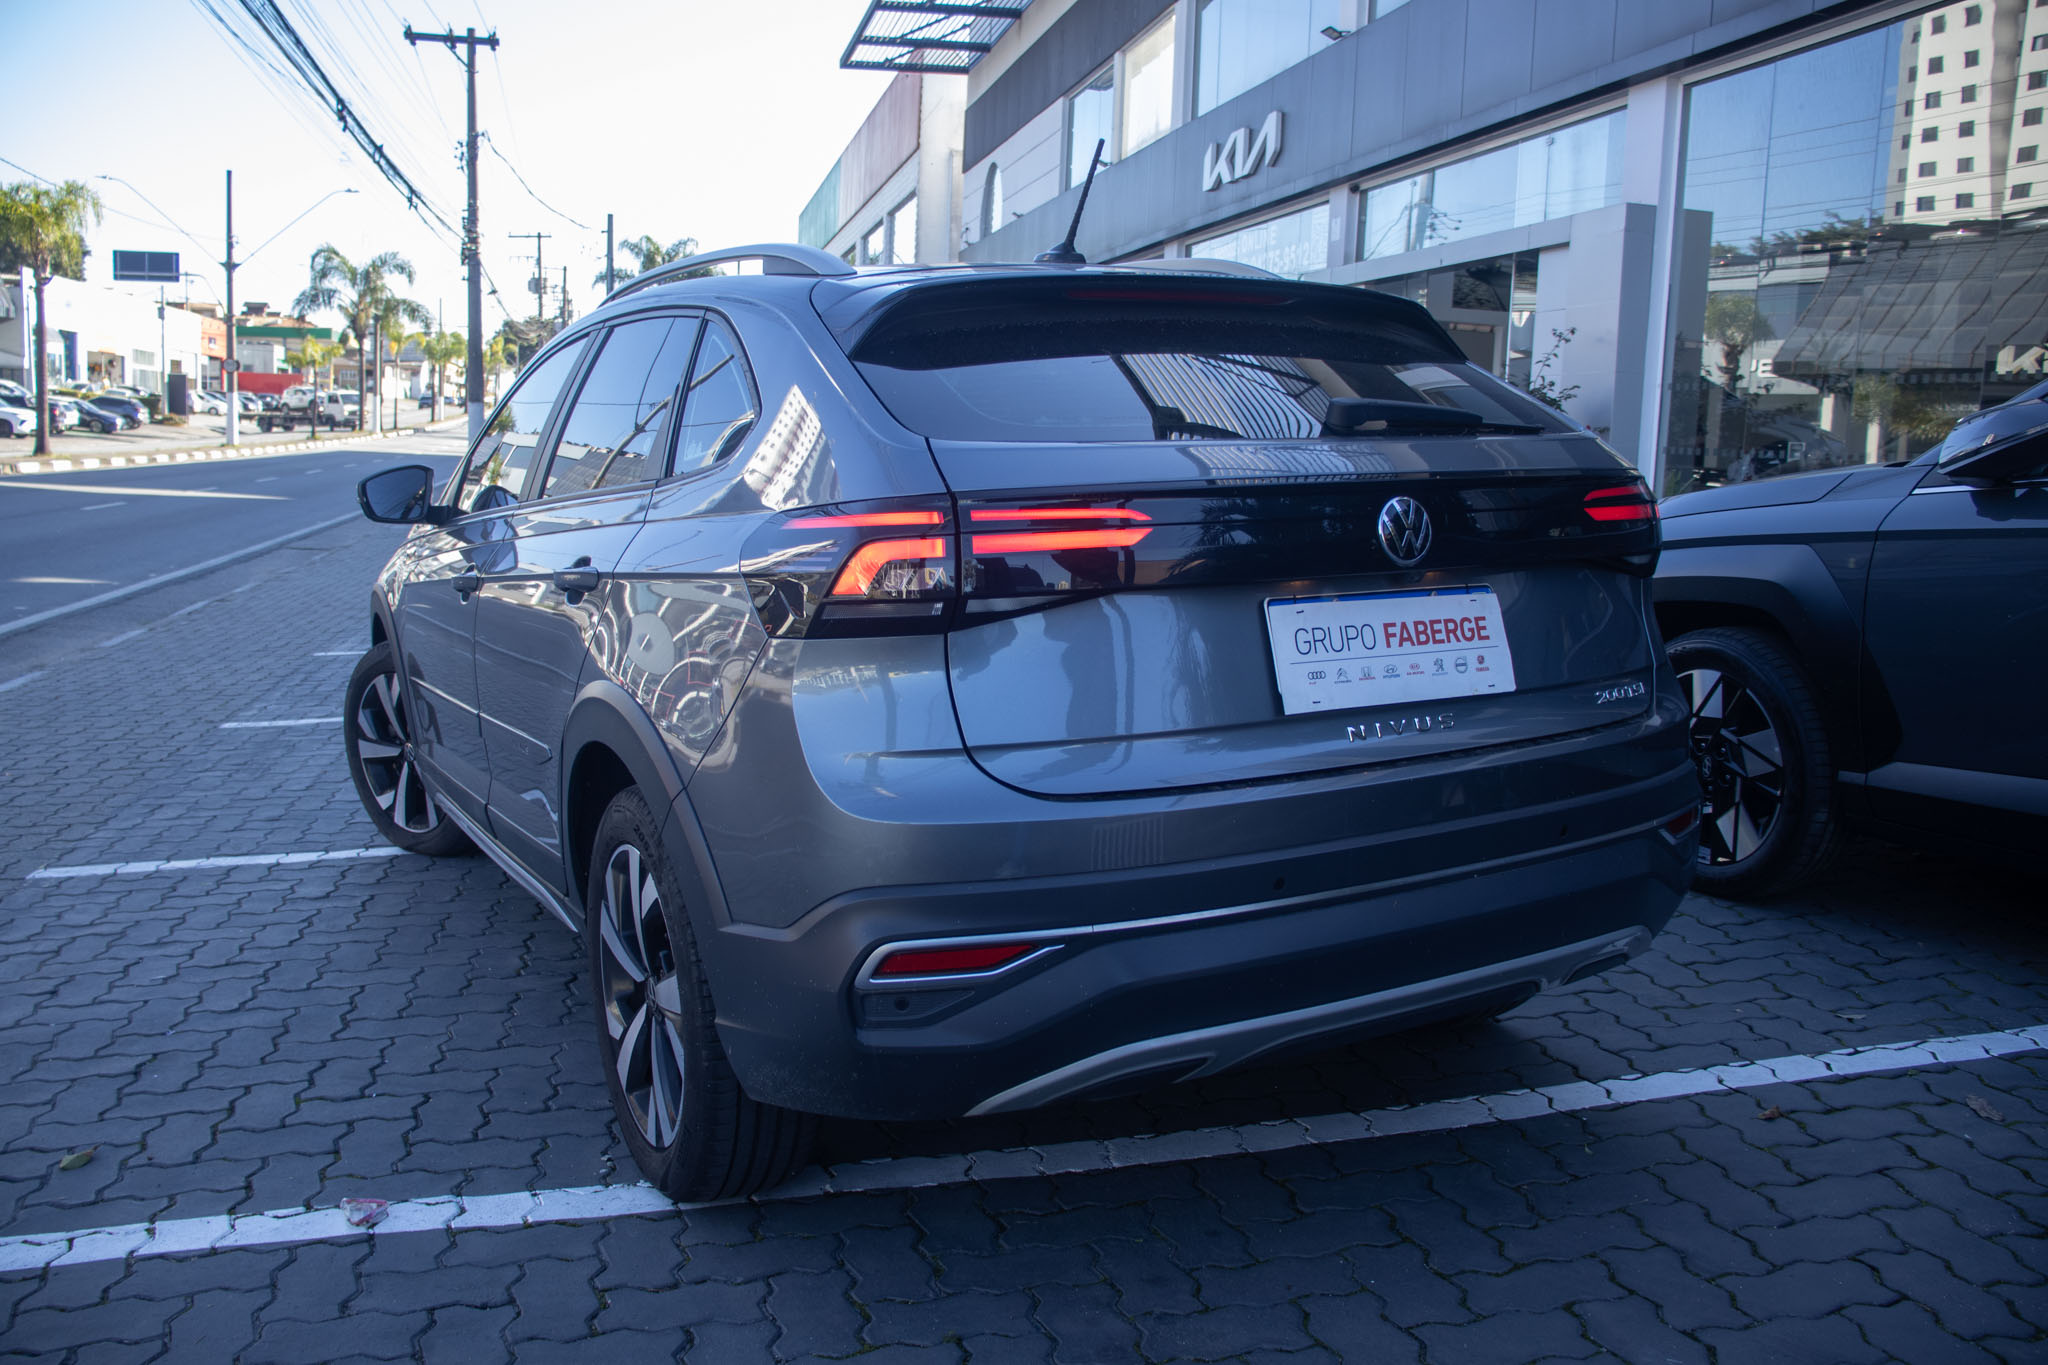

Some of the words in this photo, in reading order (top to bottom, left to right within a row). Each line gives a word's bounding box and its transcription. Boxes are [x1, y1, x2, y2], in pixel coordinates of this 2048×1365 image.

[1294, 623, 1377, 655] GRUPO
[1382, 615, 1491, 649] FABERGE
[1346, 712, 1455, 743] NIVUS
